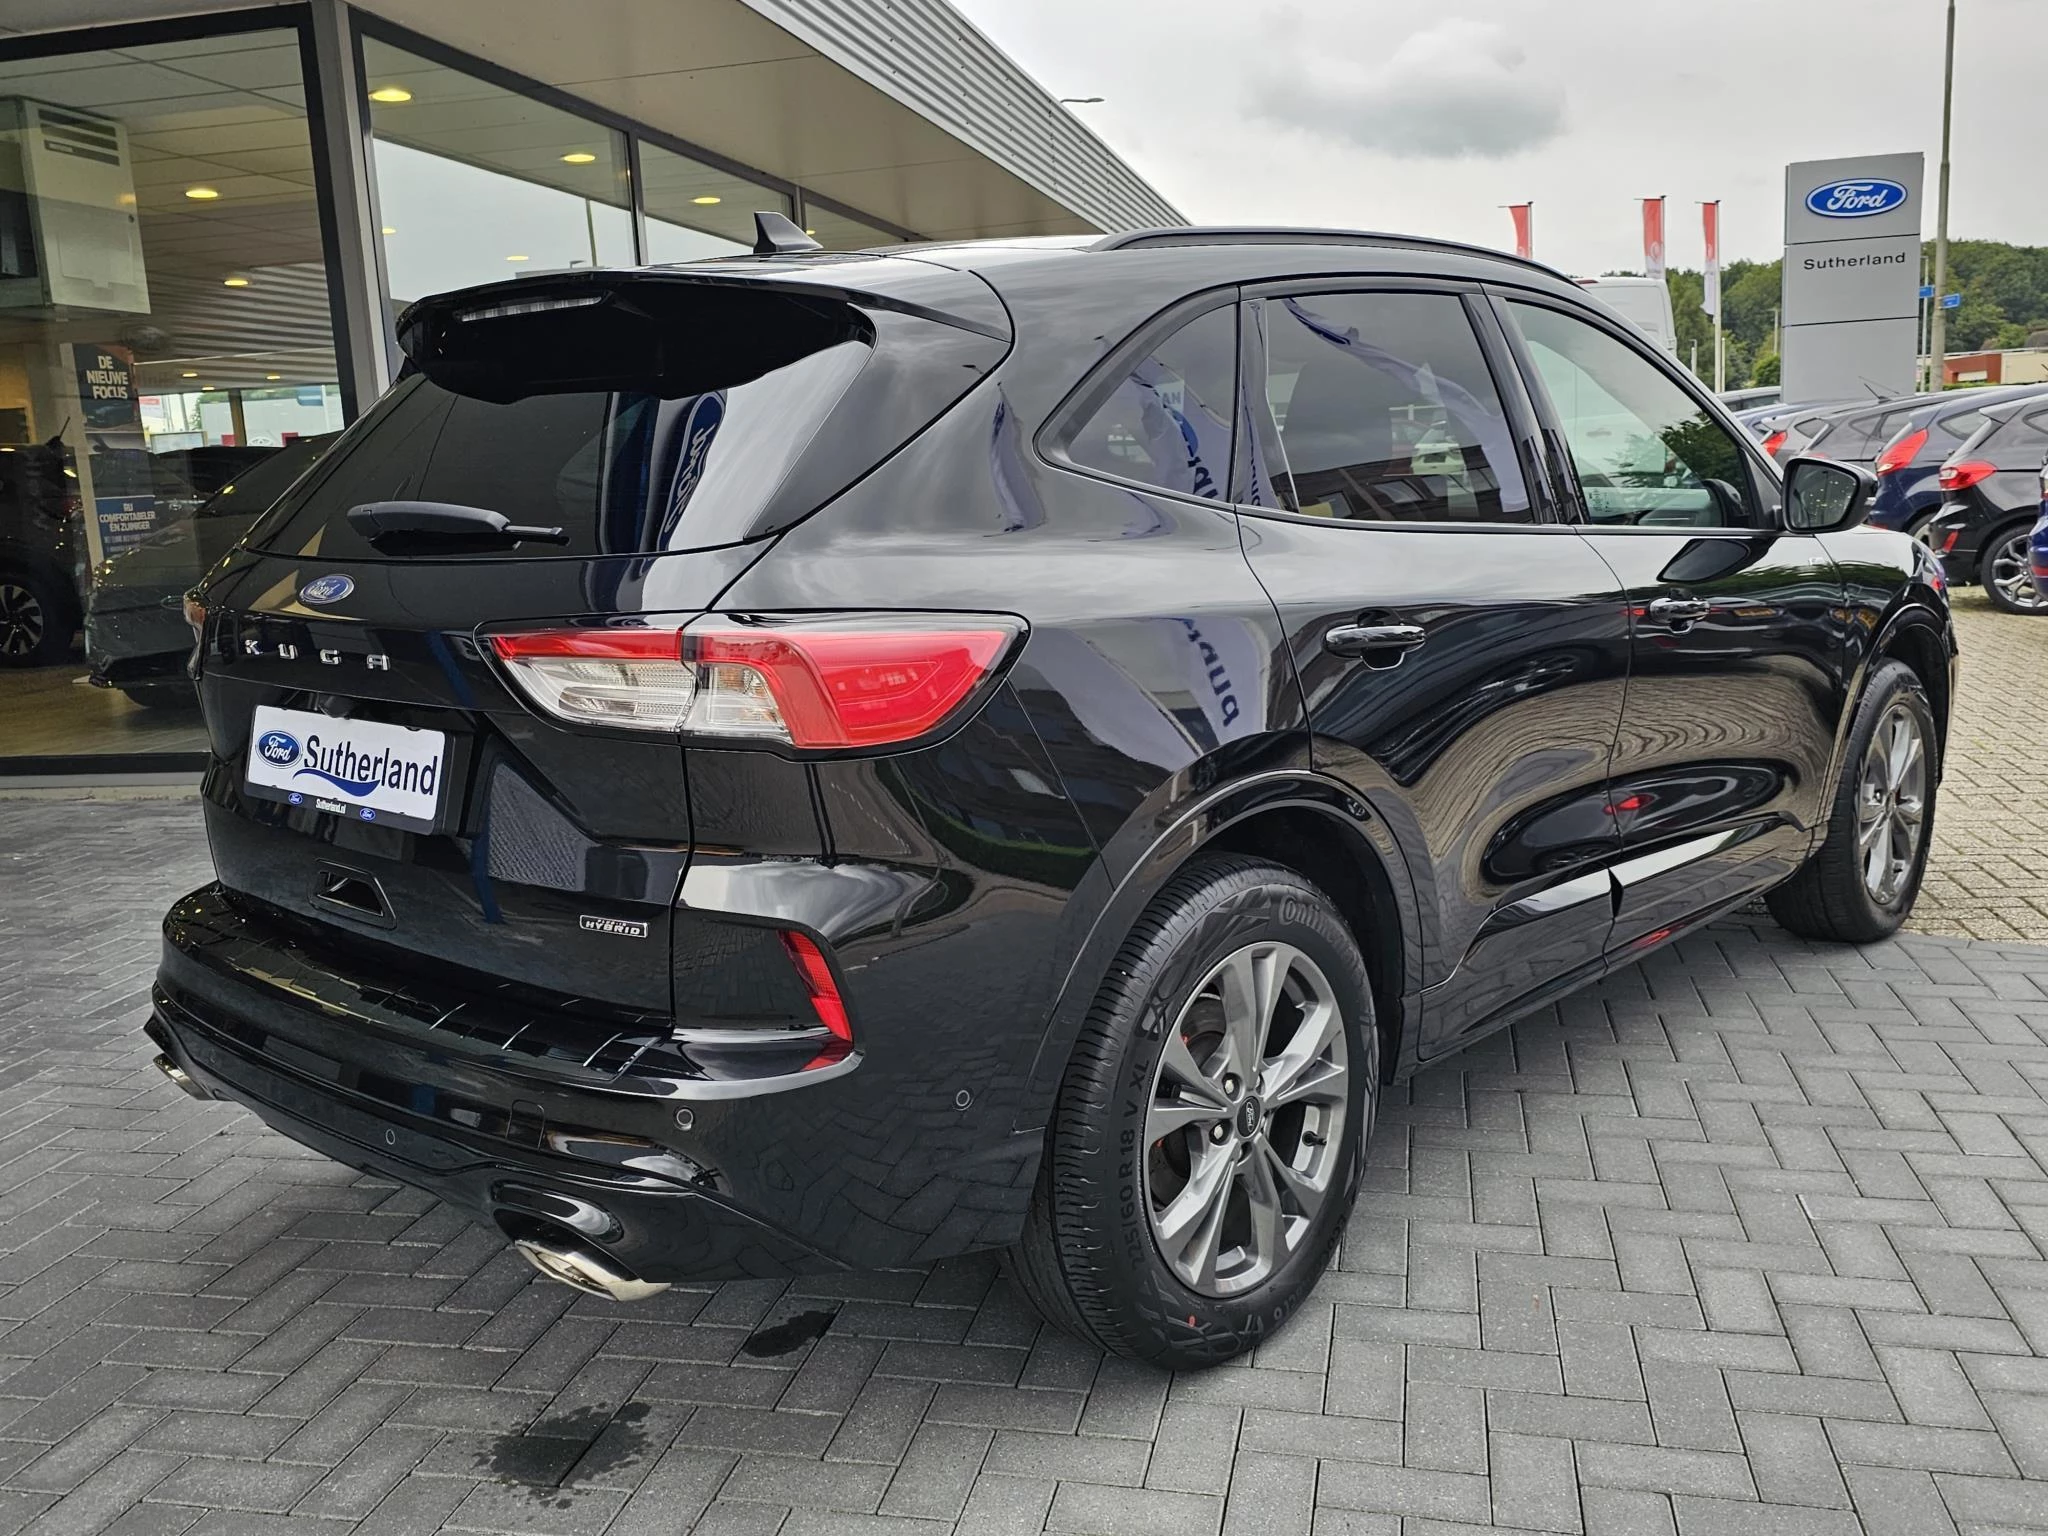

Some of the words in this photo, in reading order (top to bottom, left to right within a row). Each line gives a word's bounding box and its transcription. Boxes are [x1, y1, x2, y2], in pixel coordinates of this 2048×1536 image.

[1827, 184, 1889, 211] Ford
[1803, 252, 1906, 271] Sutherland
[97, 355, 113, 370] DE
[86, 370, 129, 386] NIEUWE
[92, 386, 128, 400] FOCUS
[244, 639, 391, 671] KUGA
[264, 733, 291, 762] Ford
[304, 735, 438, 796] Sutherland
[585, 920, 640, 935] HYBRID
[1129, 1059, 1149, 1092] XL
[1124, 1100, 1138, 1118] V
[1120, 1129, 1136, 1156] 18
[1119, 1161, 1133, 1179] R
